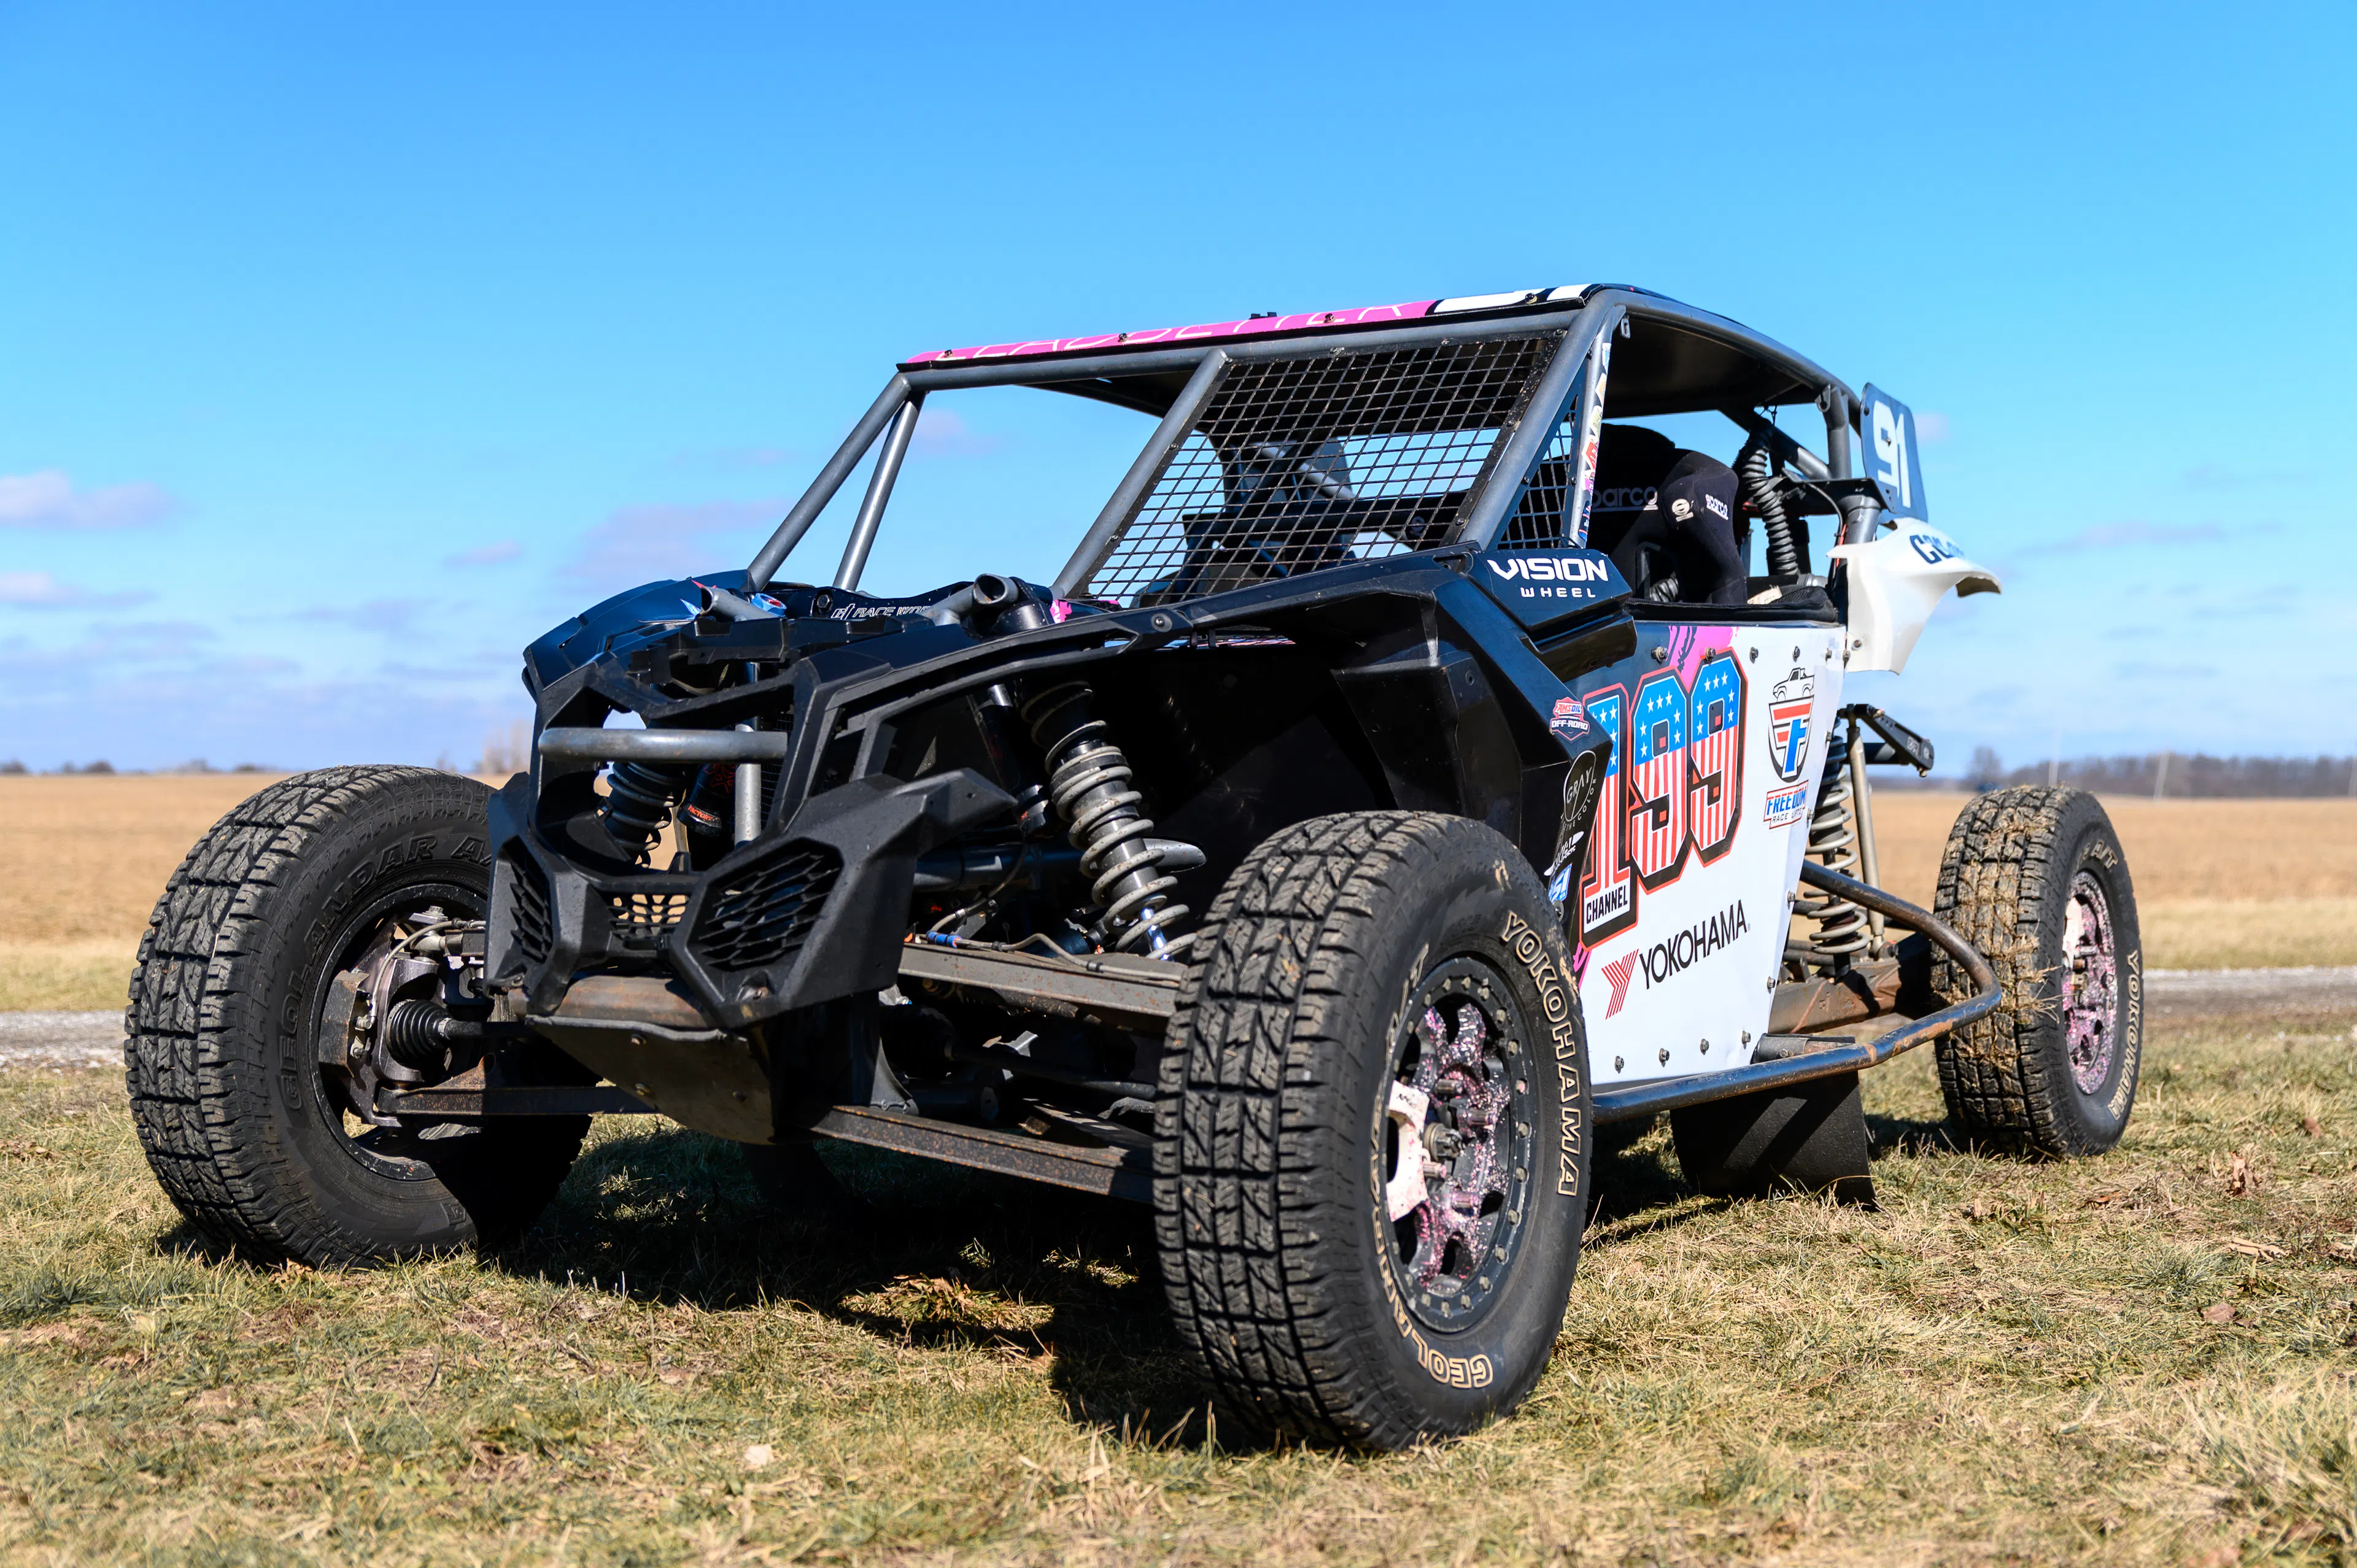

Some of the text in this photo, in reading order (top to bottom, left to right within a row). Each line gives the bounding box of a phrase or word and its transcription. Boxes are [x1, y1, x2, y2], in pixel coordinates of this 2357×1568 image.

[1873, 400, 1911, 508] 91
[1592, 485, 1658, 508] parco
[1487, 558, 1609, 582] VISION
[1520, 587, 1596, 598] WHEEL
[1557, 704, 1581, 713] AMSOIL
[1552, 720, 1589, 730] OFF-ROAD
[1566, 767, 1592, 804] GRAY
[1584, 649, 1746, 897] 199
[687, 804, 713, 821] FACTORY
[1767, 786, 1806, 816] FREEDOM
[1773, 813, 1789, 822] RACE
[1586, 885, 1628, 924] CHANNEL
[1639, 900, 1747, 989] YOKOHAMA
[2107, 949, 2140, 1121] YOKOHAMA
[1501, 910, 1582, 1197] YOKOHAMA
